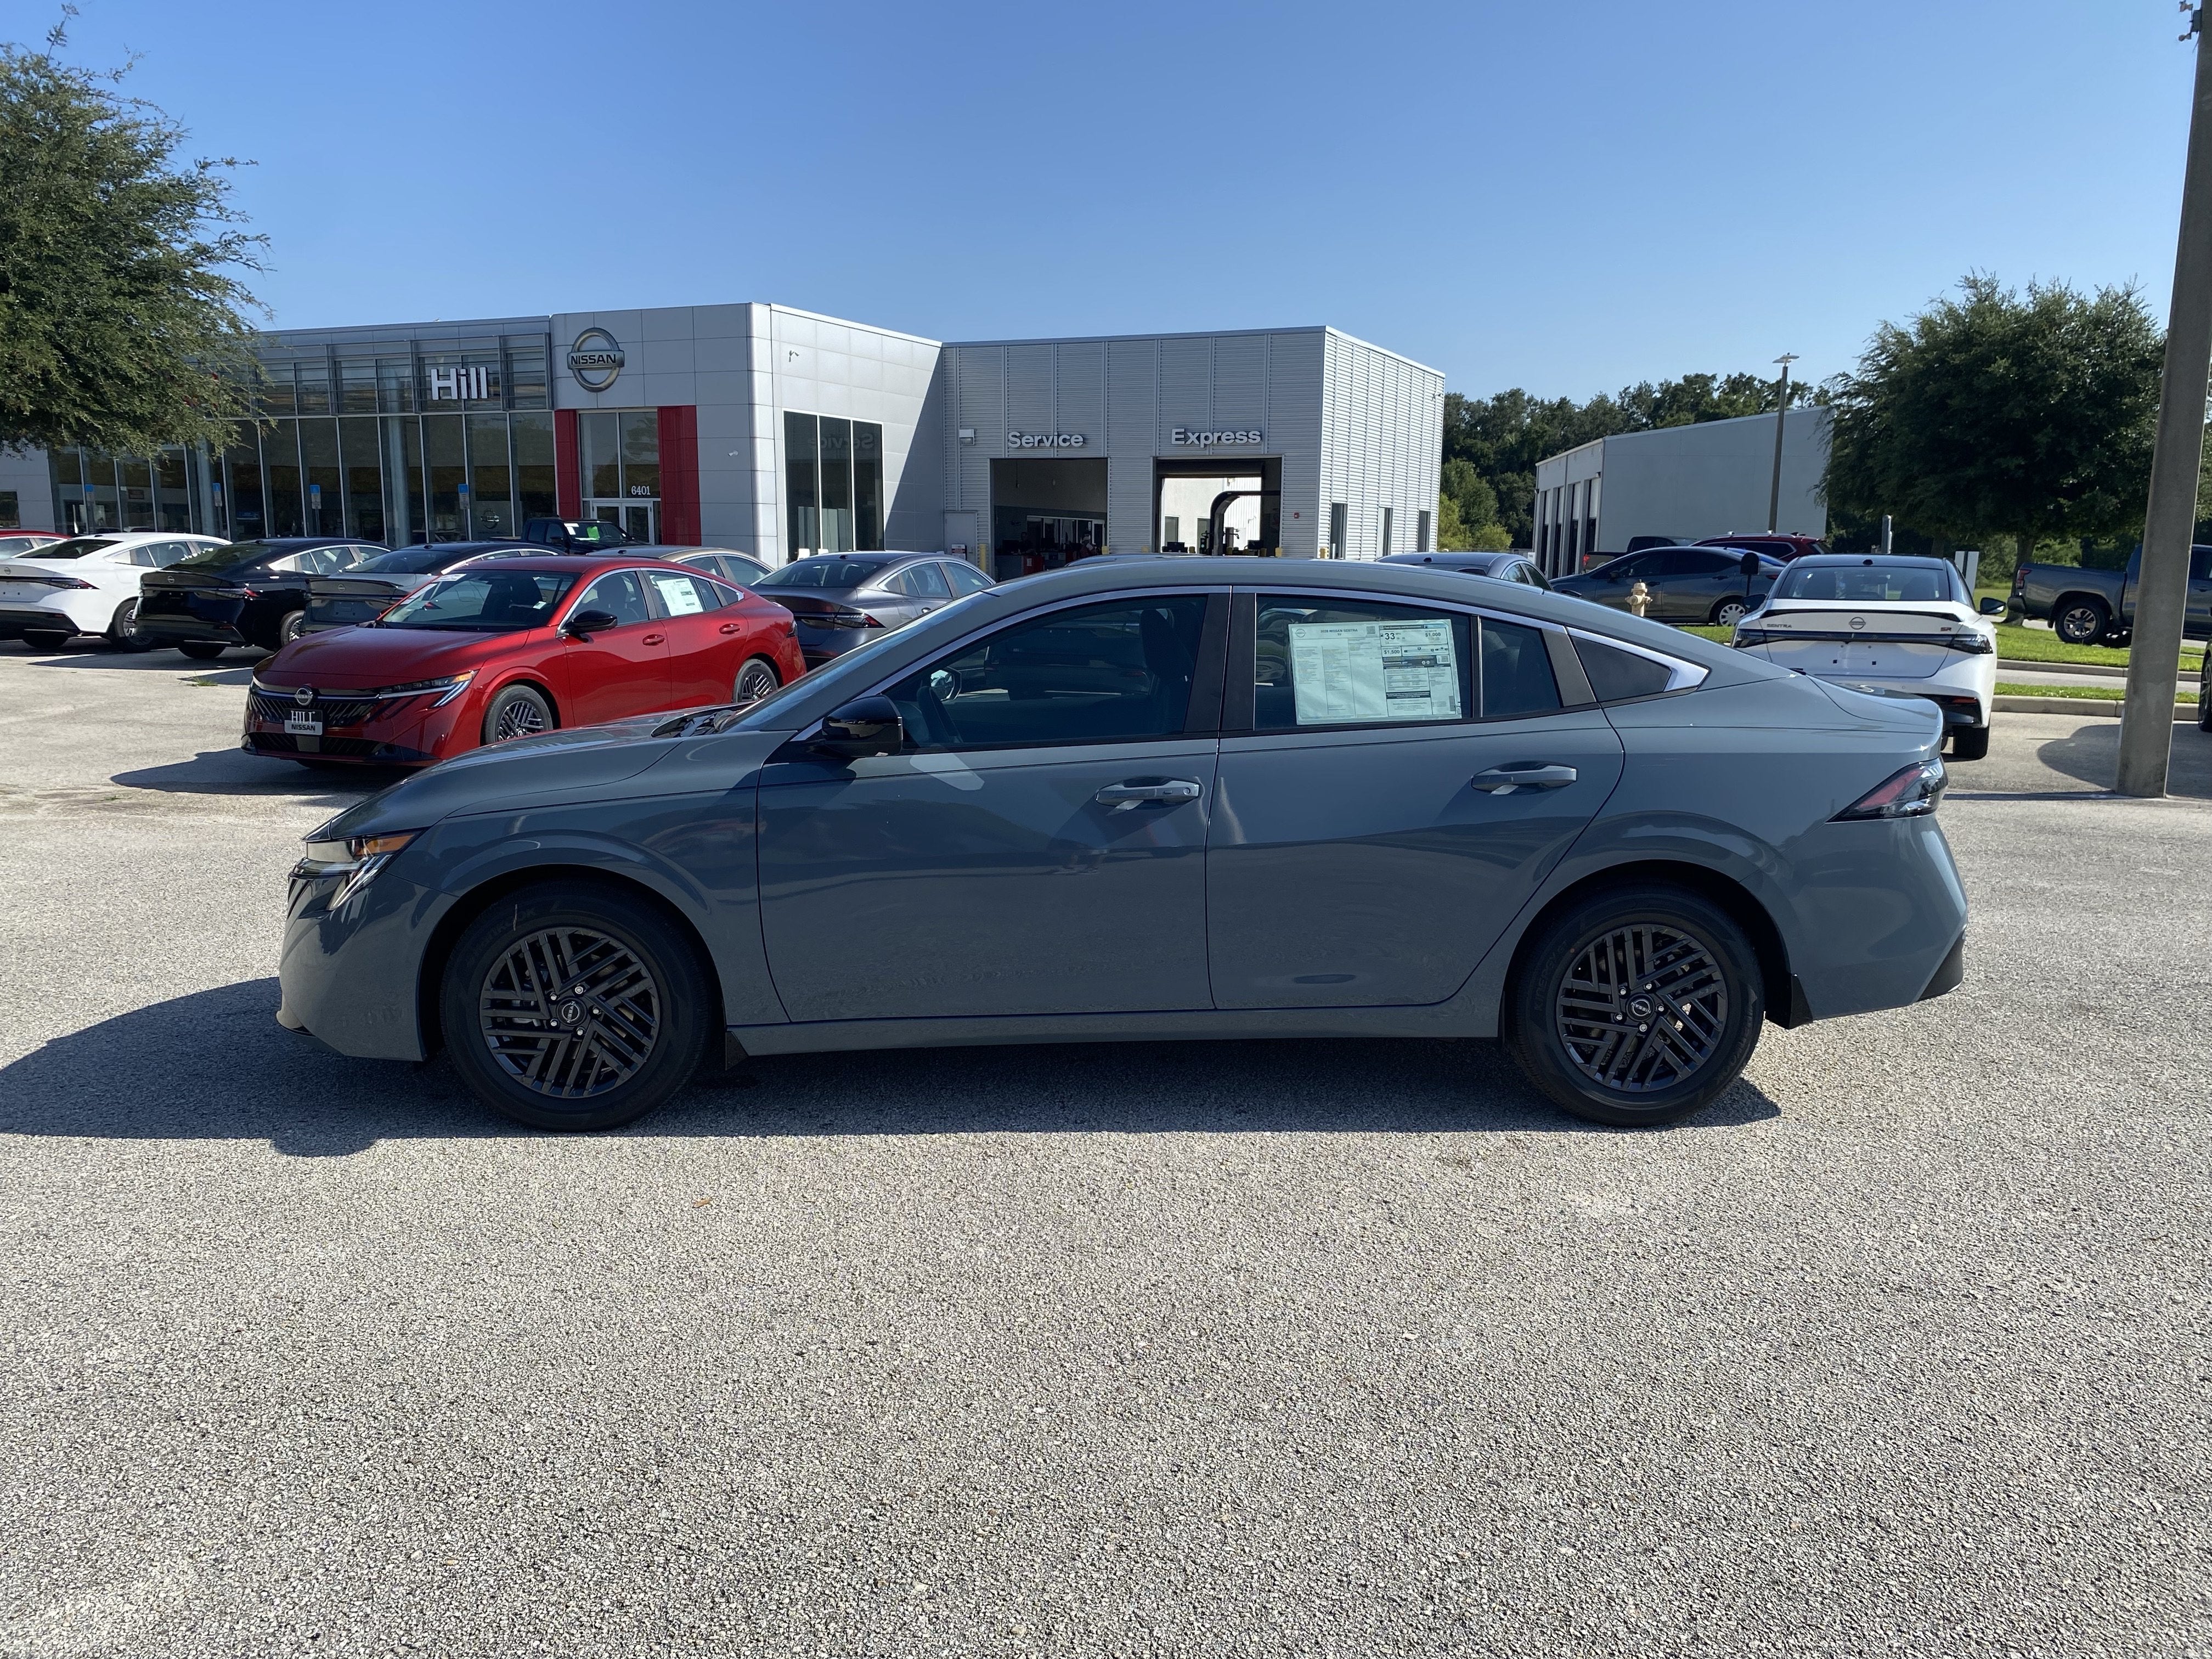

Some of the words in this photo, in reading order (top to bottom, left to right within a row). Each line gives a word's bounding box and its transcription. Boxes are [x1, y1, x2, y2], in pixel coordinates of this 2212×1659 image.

[571, 354, 616, 365] NISSAN
[431, 366, 488, 400] Hill
[1008, 431, 1085, 448] Service
[1171, 428, 1262, 448] Express
[631, 485, 651, 495] 6401
[291, 710, 315, 724] HILL
